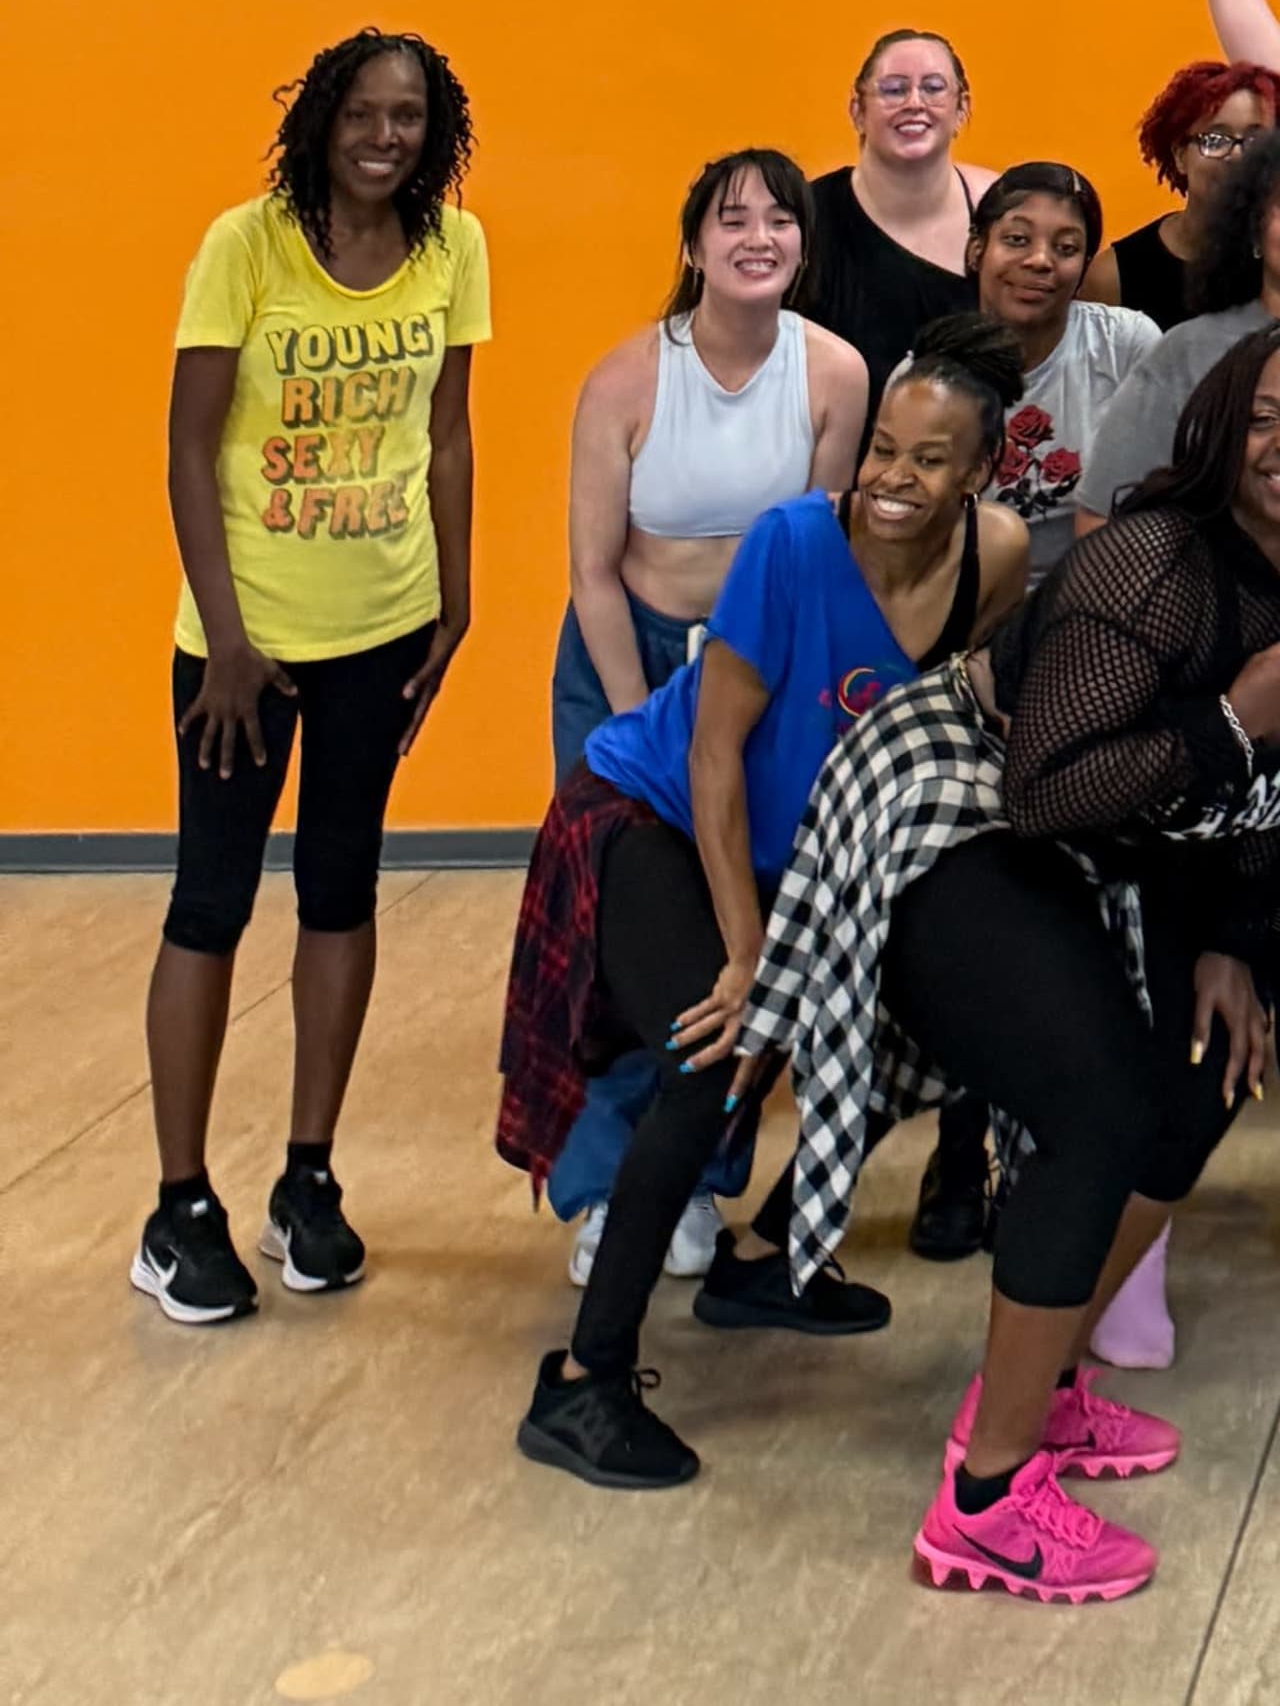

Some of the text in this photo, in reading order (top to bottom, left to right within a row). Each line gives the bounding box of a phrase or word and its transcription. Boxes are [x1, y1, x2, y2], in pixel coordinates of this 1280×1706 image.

[266, 312, 434, 376] YOUNG
[282, 365, 417, 428] RICH
[261, 425, 386, 486] SEXY
